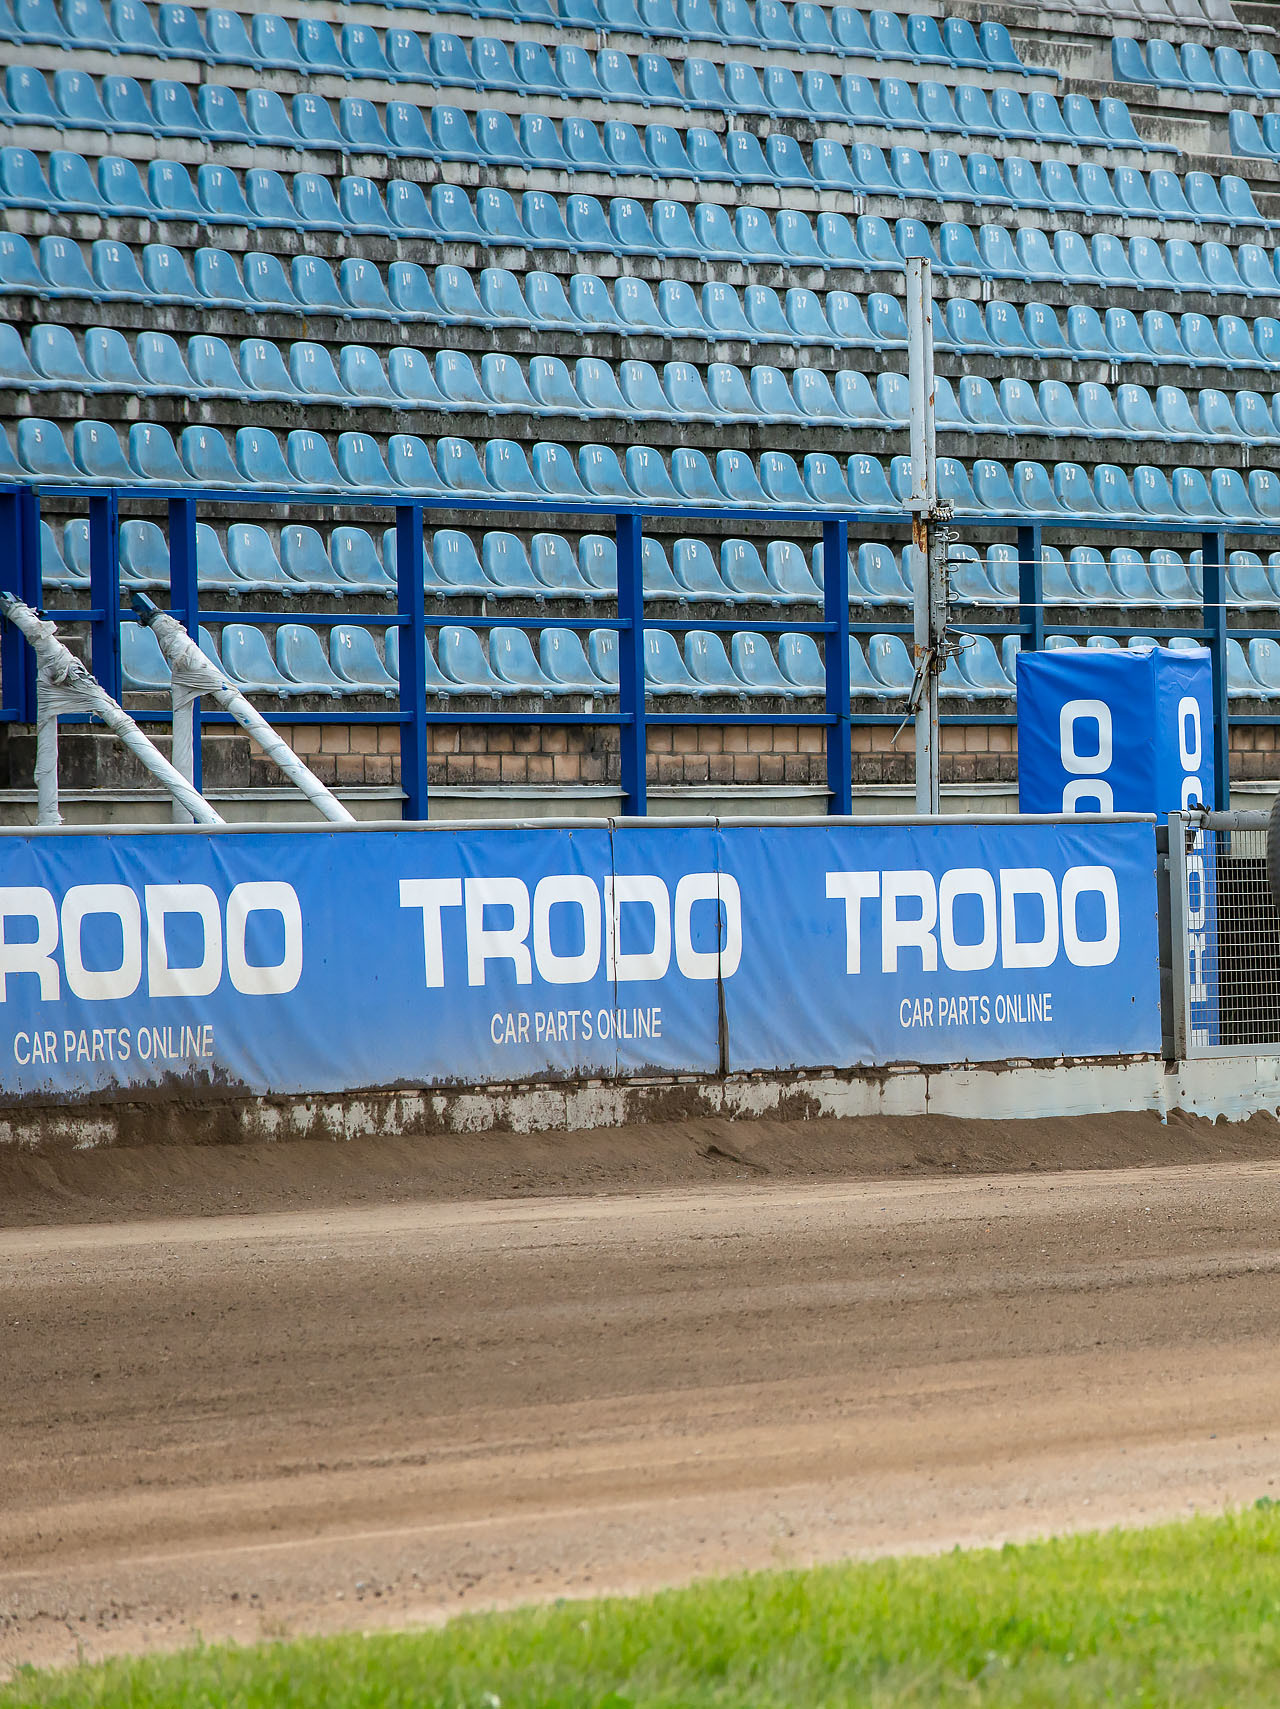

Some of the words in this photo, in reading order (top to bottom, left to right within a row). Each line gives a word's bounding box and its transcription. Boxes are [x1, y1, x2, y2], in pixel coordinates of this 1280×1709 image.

[399, 873, 742, 987] TRODO
[826, 866, 1120, 974] TRODO
[491, 1012, 530, 1044] CAR
[535, 1010, 593, 1042] PARTS
[598, 1007, 662, 1040] ONLINE
[900, 998, 934, 1028] CAR
[939, 995, 990, 1026] PARTS
[995, 993, 1053, 1023] ONLINE
[14, 1031, 58, 1065] CAR
[64, 1027, 131, 1063] PARTS
[138, 1025, 214, 1060] ONLINE
